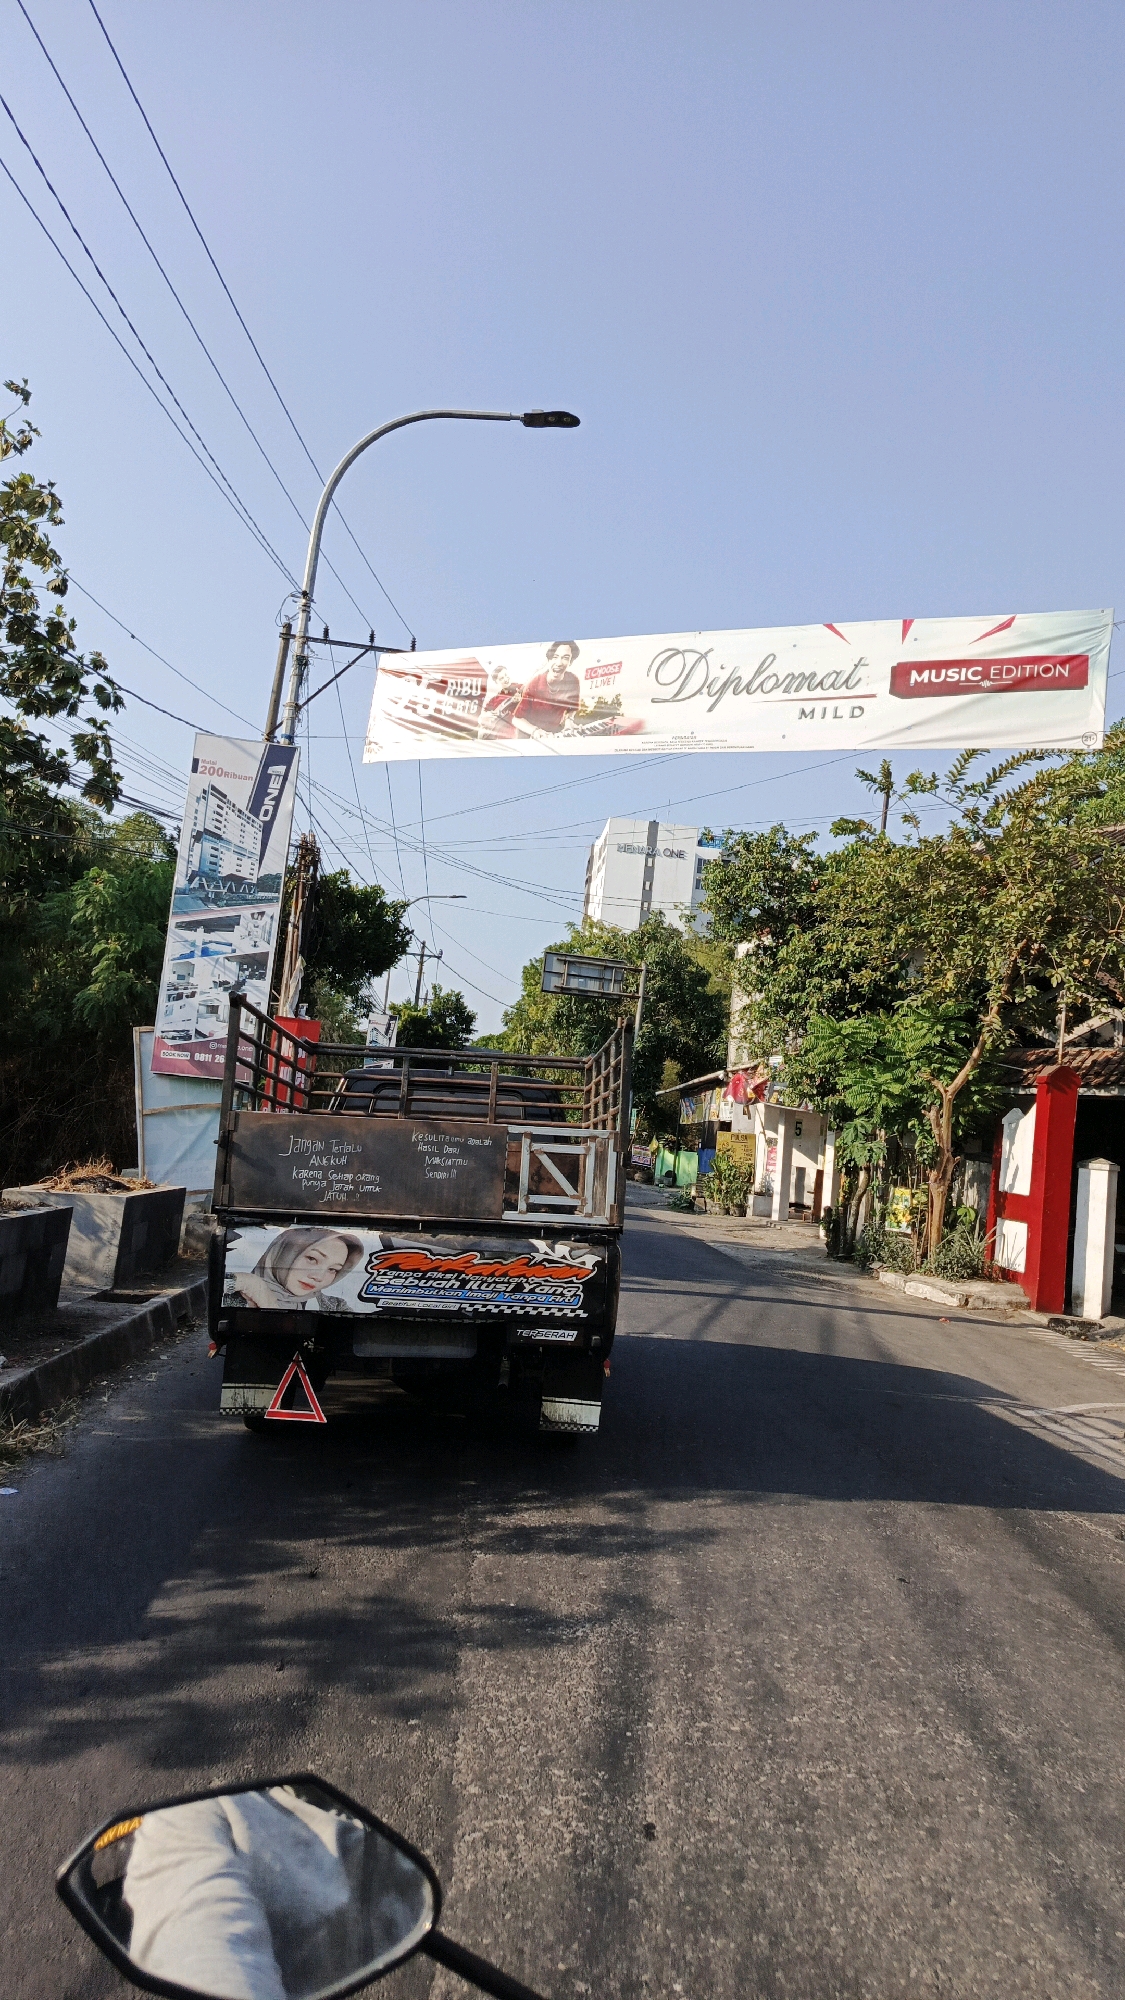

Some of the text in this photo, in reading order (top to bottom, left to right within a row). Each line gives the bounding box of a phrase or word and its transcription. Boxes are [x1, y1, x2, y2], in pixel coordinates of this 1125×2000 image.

[590, 664, 620, 677] CHOOSE
[910, 664, 1069, 684] MUSIC EDITION
[445, 678, 482, 696] RIBU
[647, 647, 869, 713] Diplomat
[798, 706, 865, 720] MILD
[201, 758, 218, 766] Mulai
[258, 774, 284, 821] ONE
[616, 842, 686, 859] MENARA ONE
[194, 1052, 212, 1062] 0811
[795, 1121, 802, 1136] 5
[373, 1252, 593, 1280] Perkataan
[378, 1269, 528, 1283] Tanpa Aksi Hanyalah
[370, 1286, 463, 1297] Menimbulkan
[464, 1290, 500, 1300] Imaji
[502, 1292, 547, 1302] Tanpa
[371, 1276, 580, 1297] Sebuah Ilusi Yang
[516, 1329, 575, 1340] TERSERAH
